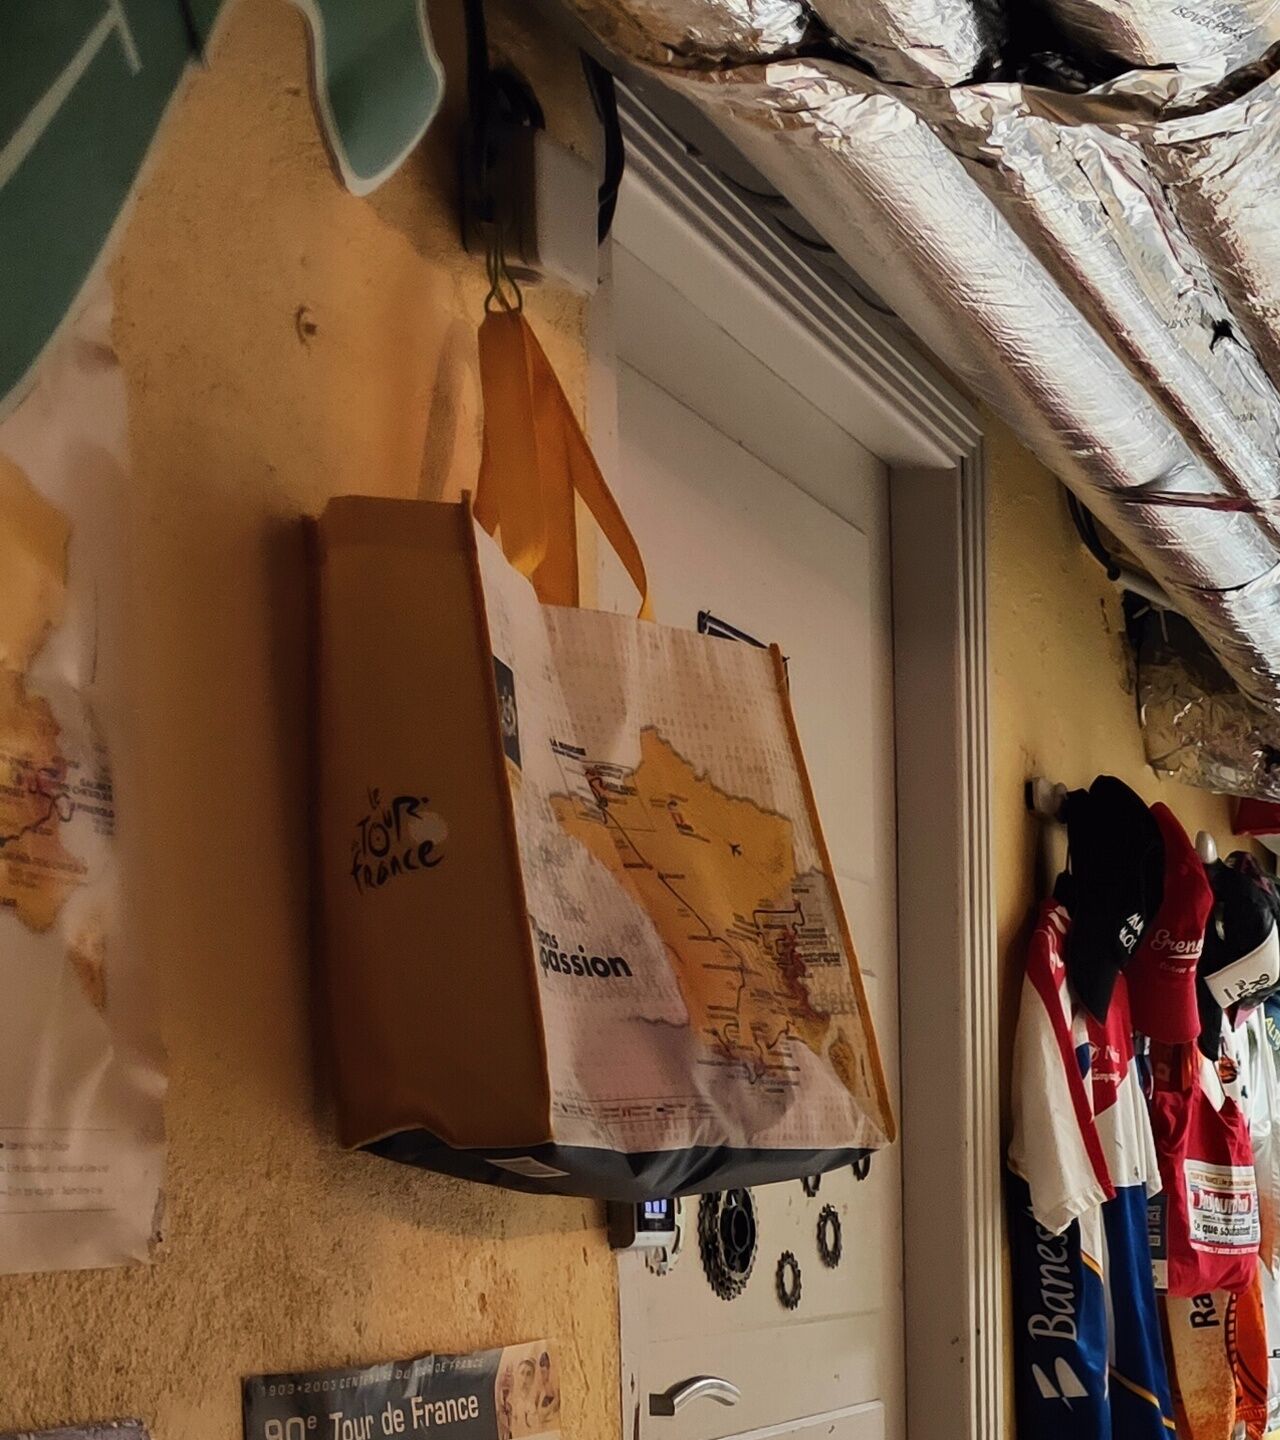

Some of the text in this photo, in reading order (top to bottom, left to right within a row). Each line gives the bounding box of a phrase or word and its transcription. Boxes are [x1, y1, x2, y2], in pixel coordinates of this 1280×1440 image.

[539, 945, 633, 978] passion
[381, 1400, 405, 1436] de
[411, 1394, 480, 1430] France
